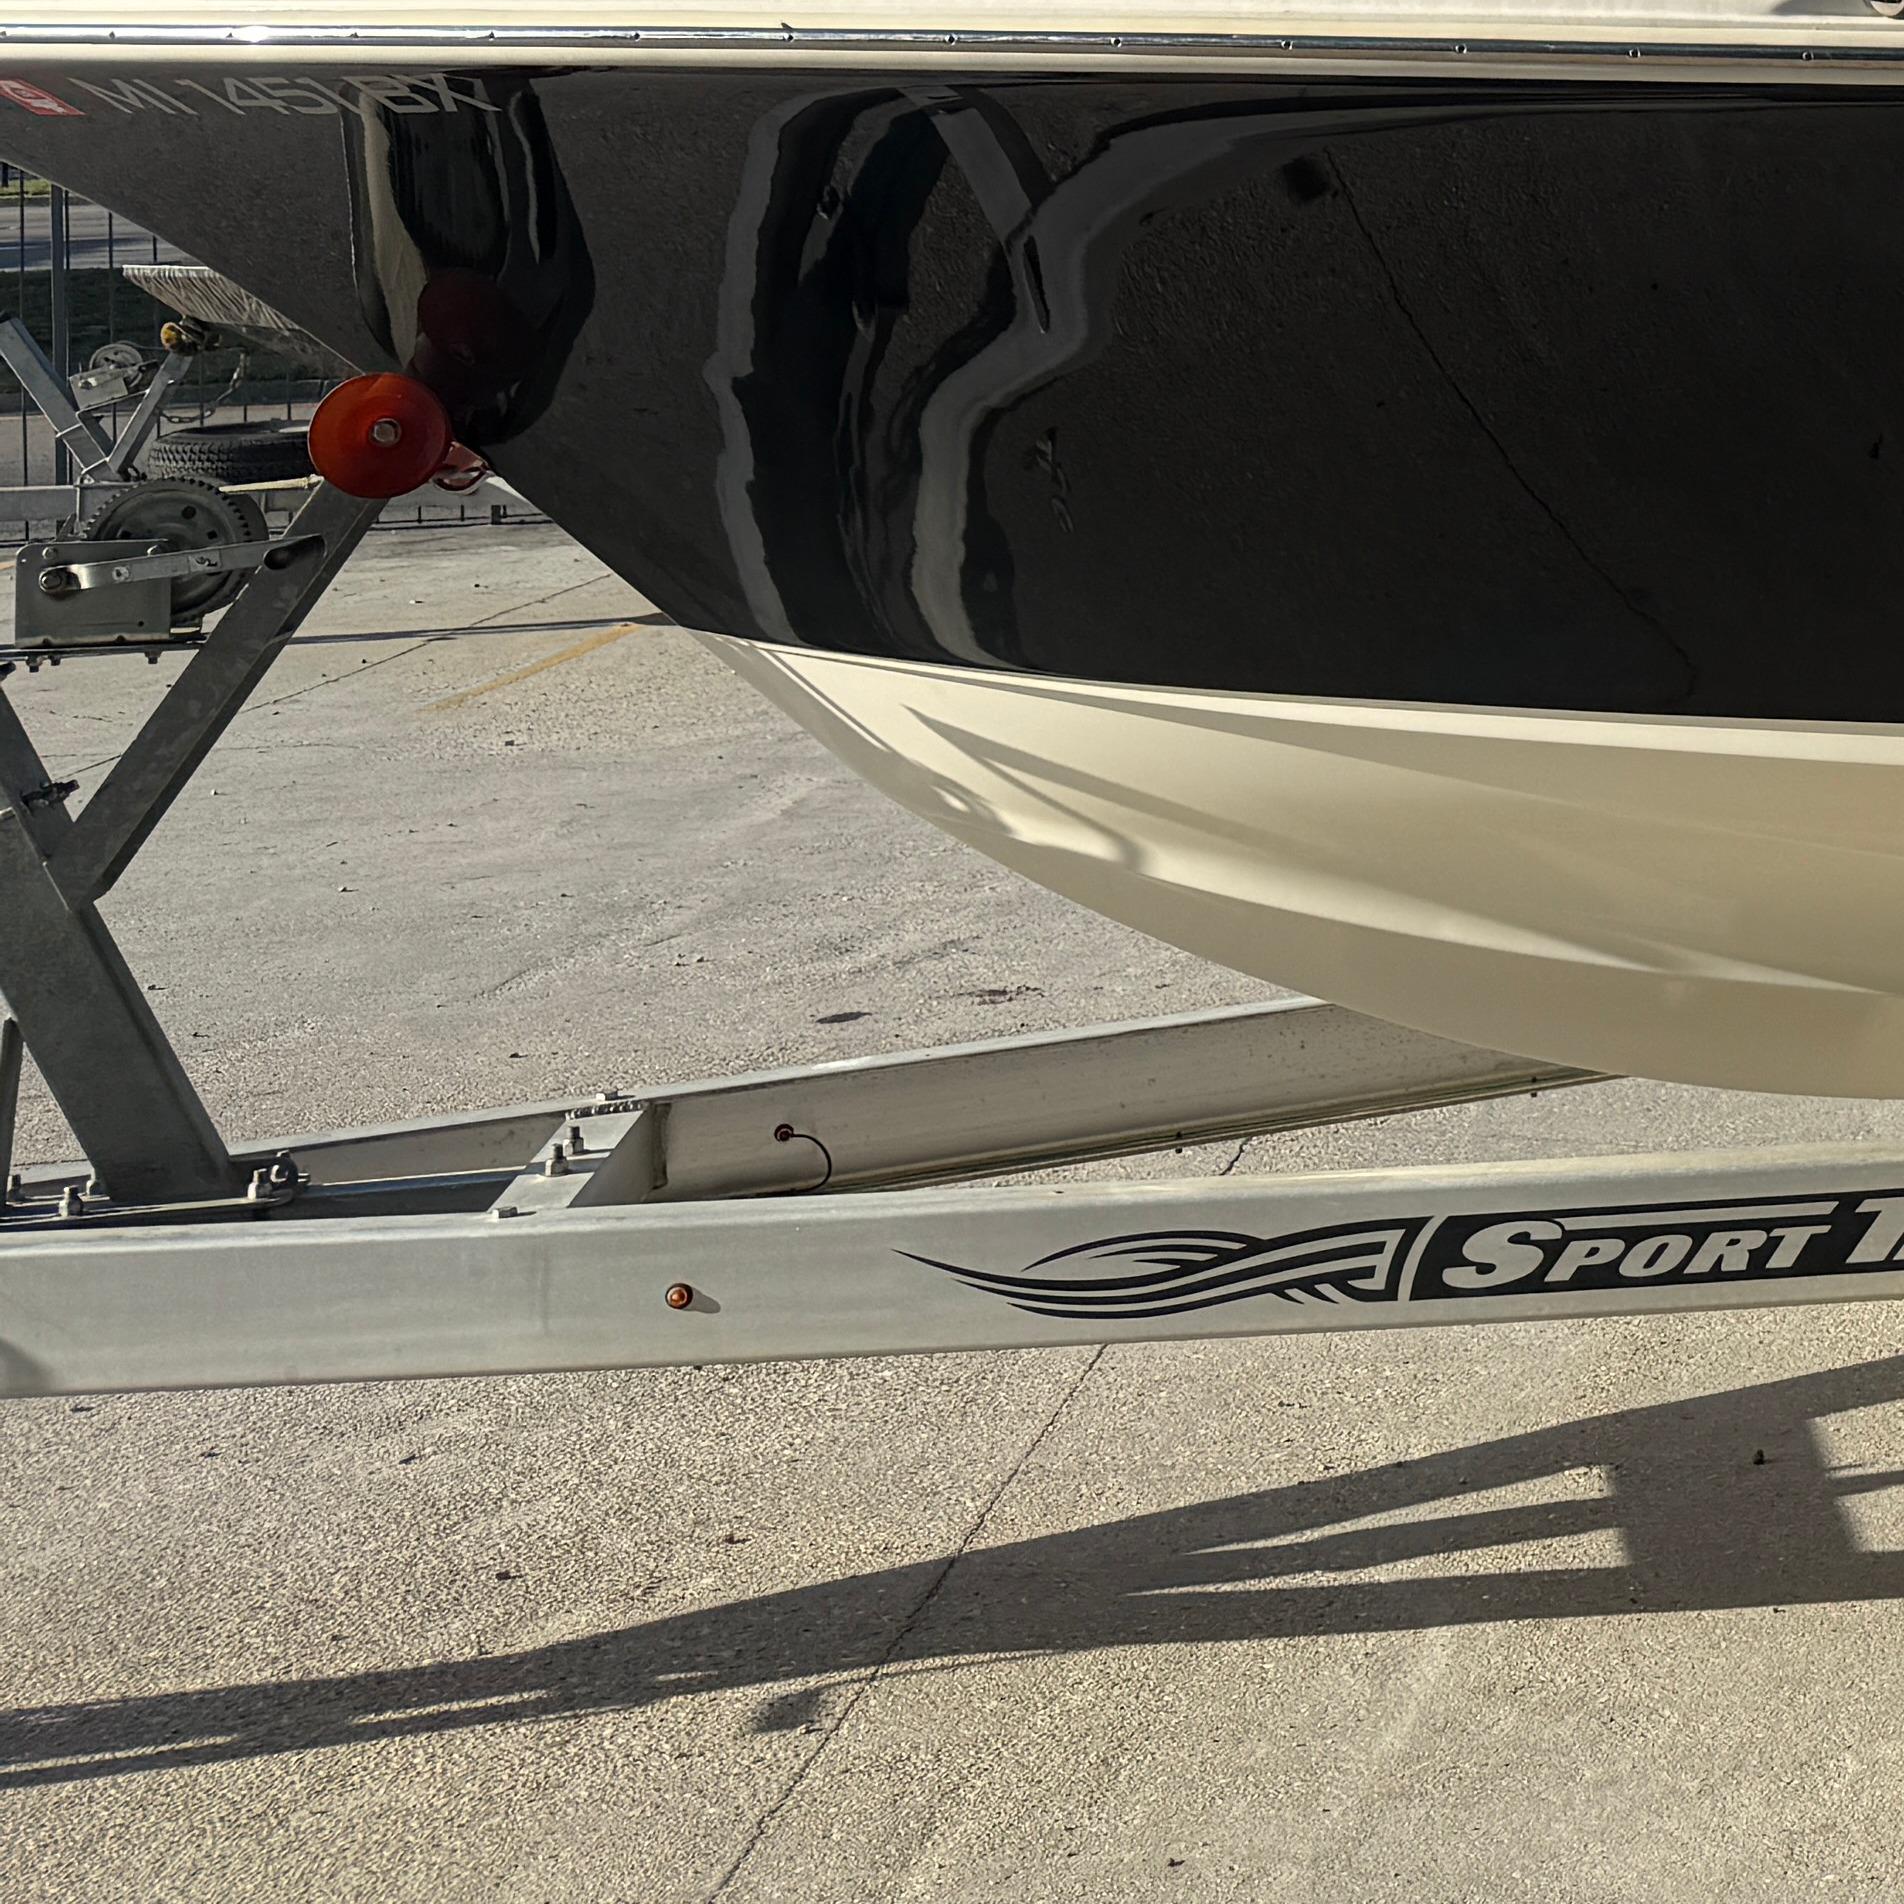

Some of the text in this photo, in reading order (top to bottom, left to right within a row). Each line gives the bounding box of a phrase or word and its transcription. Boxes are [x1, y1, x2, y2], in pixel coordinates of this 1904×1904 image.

[66, 77, 200, 114] MI
[174, 76, 364, 115] 1451
[341, 72, 503, 114] BX
[1441, 1201, 1839, 1290] SPORT
